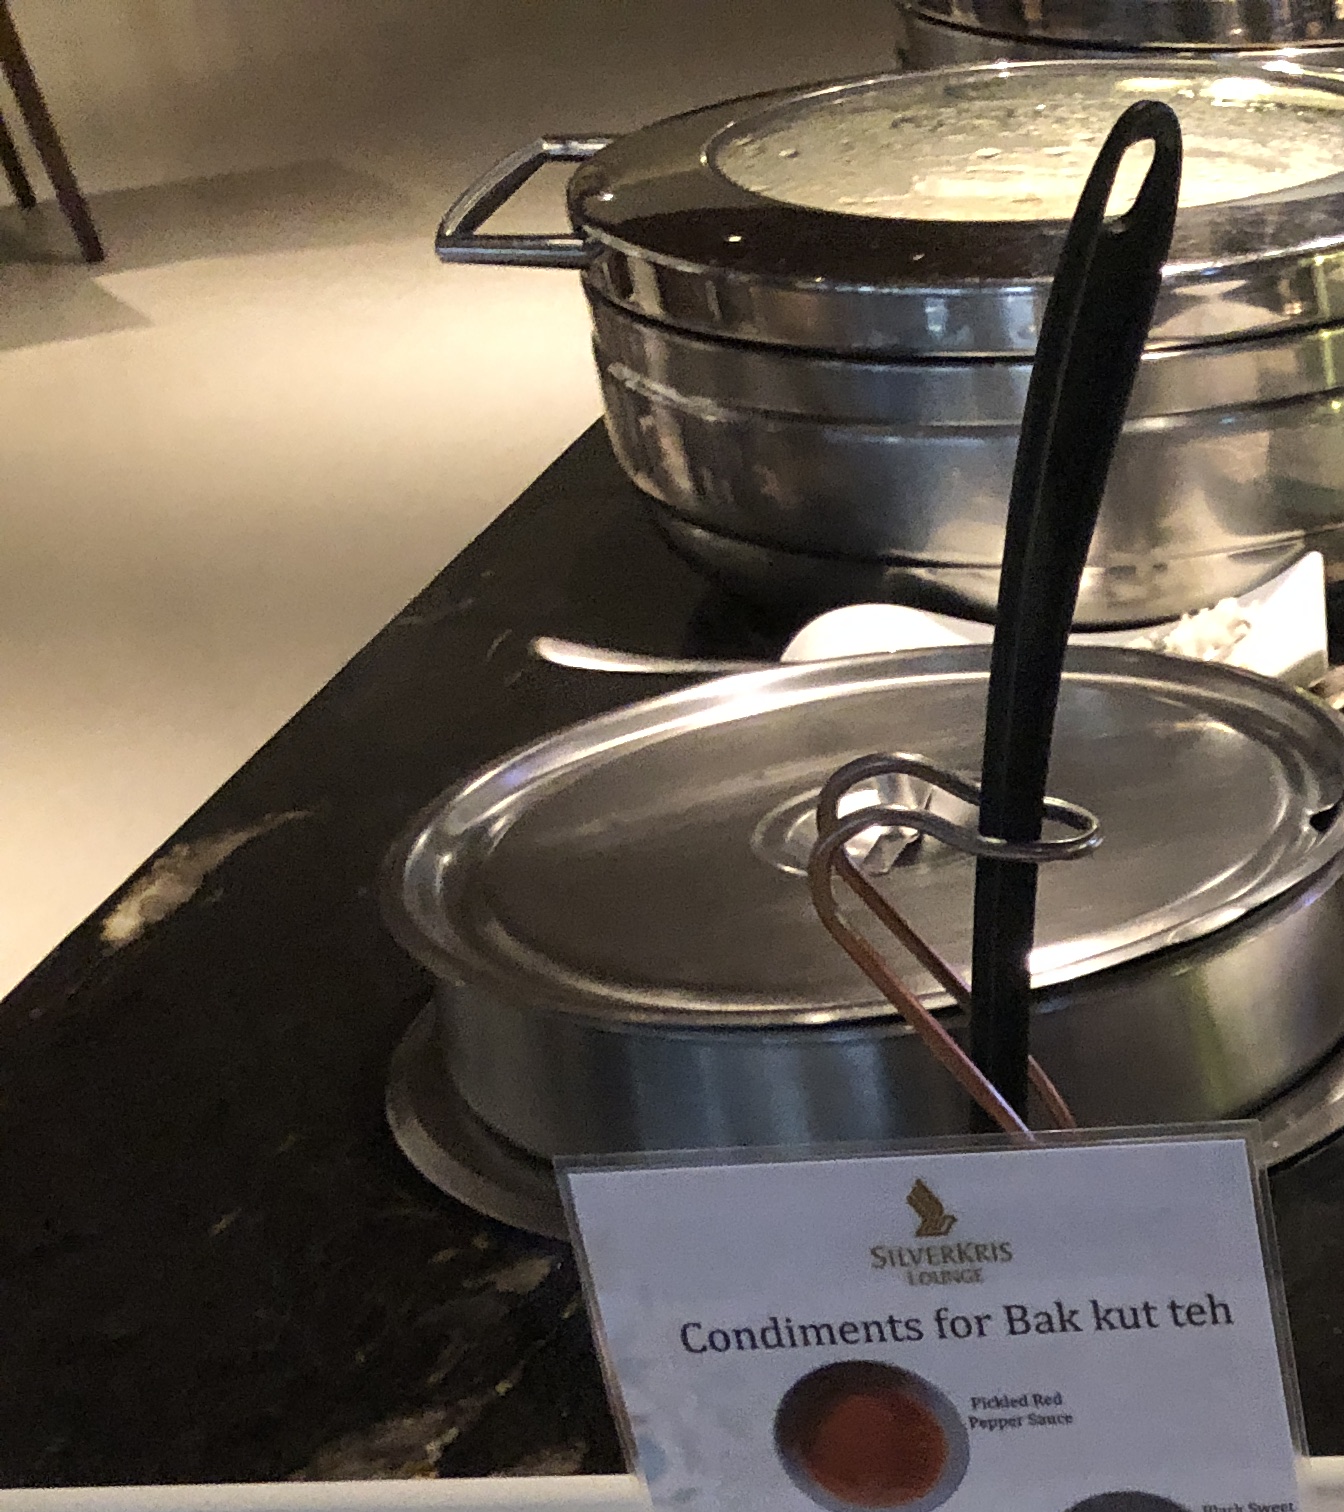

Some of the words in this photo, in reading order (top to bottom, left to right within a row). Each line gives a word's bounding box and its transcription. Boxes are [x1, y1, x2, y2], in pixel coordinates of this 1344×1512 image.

[906, 1268, 984, 1286] LOUNGE
[680, 1315, 924, 1355] Condiments
[935, 1306, 992, 1340] for
[1003, 1301, 1083, 1337] Bak
[1093, 1299, 1159, 1331] kut
[1170, 1293, 1234, 1326] teh
[970, 1393, 1028, 1410] Pickled
[1032, 1391, 1063, 1409] Red
[967, 1415, 1022, 1431] Pepper
[1027, 1412, 1073, 1426] Sauce
